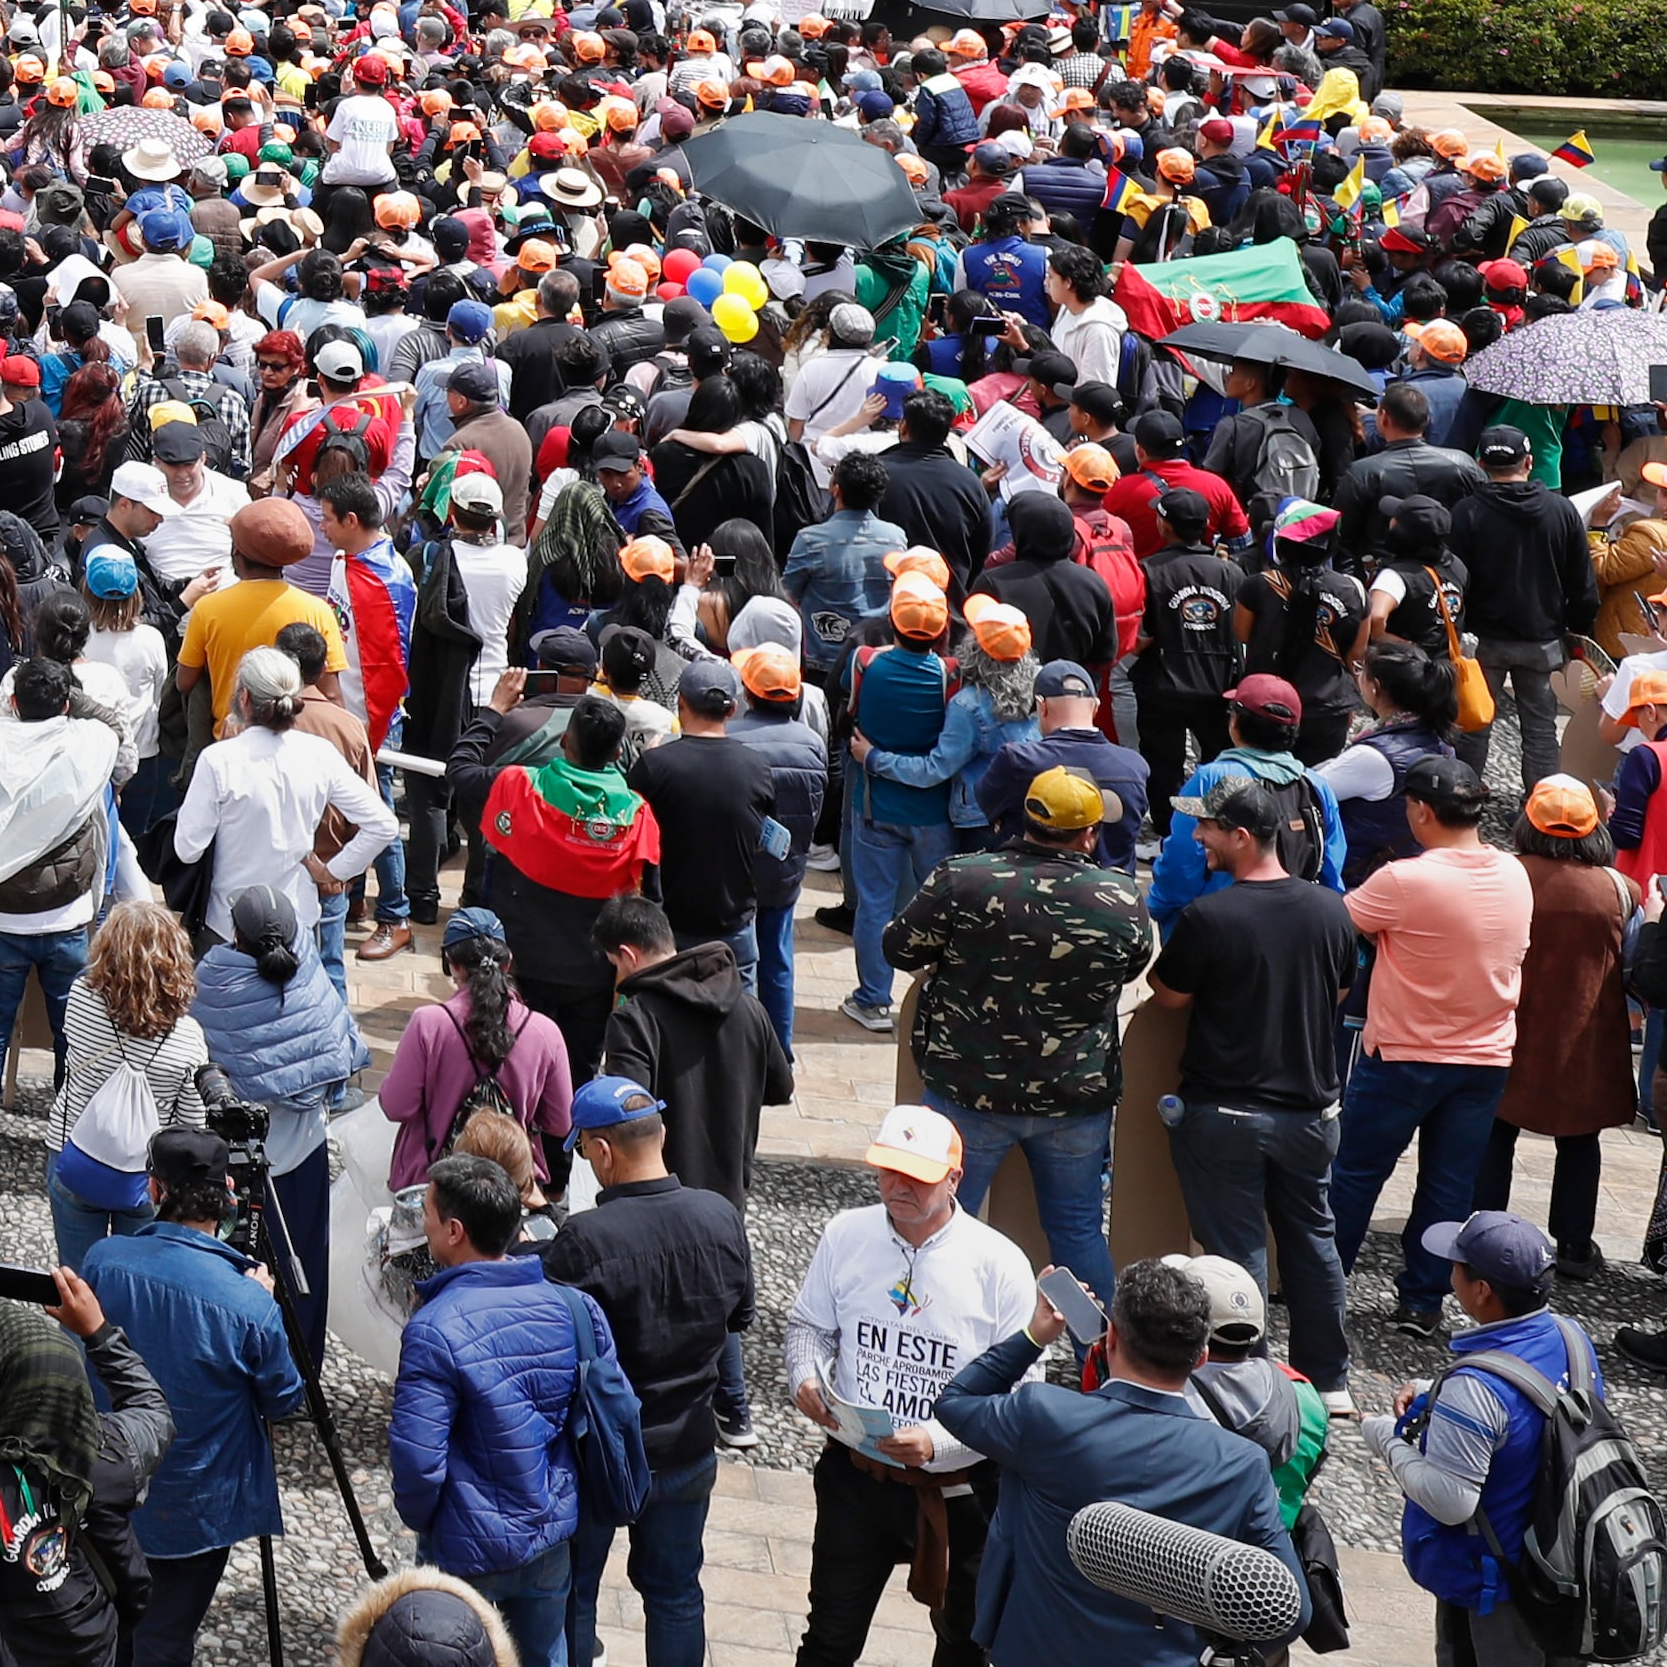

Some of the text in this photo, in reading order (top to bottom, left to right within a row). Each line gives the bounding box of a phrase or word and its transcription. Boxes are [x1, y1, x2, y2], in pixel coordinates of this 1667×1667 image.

[18, 430, 50, 455] STONES
[249, 1210, 260, 1248] SONY
[856, 1321, 958, 1370] EN ESTE
[906, 1324, 923, 1335] DEL
[855, 1359, 950, 1400] LAS FIESTAS
[856, 1347, 955, 1381] PARCHE APROBAMOS
[882, 1389, 935, 1421] AMO
